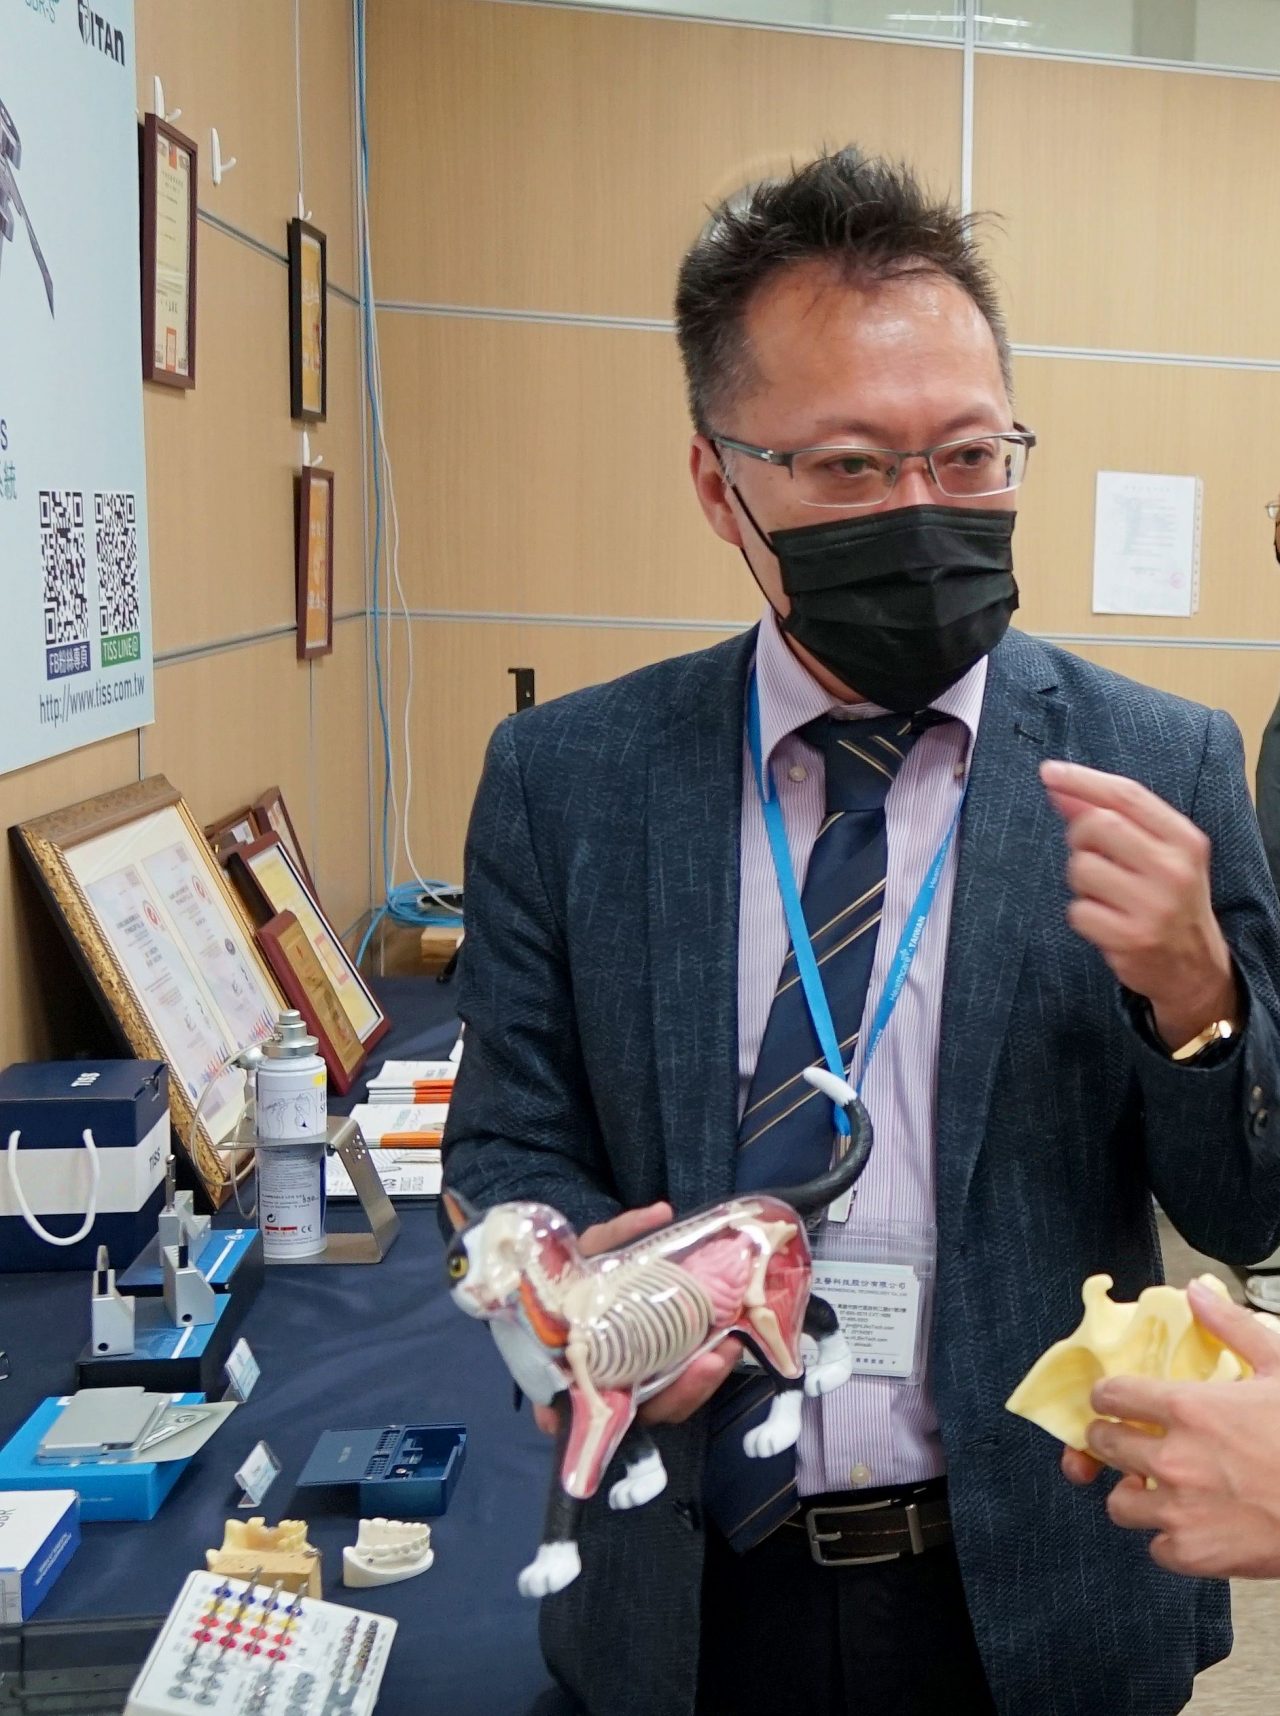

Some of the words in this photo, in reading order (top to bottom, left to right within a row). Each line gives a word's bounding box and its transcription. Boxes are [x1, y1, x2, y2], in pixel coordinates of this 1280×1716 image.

[0, 460, 17, 501] 統
[102, 640, 118, 662] TISS
[39, 672, 145, 729] http://www.tiss.com.tw
[908, 915, 926, 948] TAIWAN
